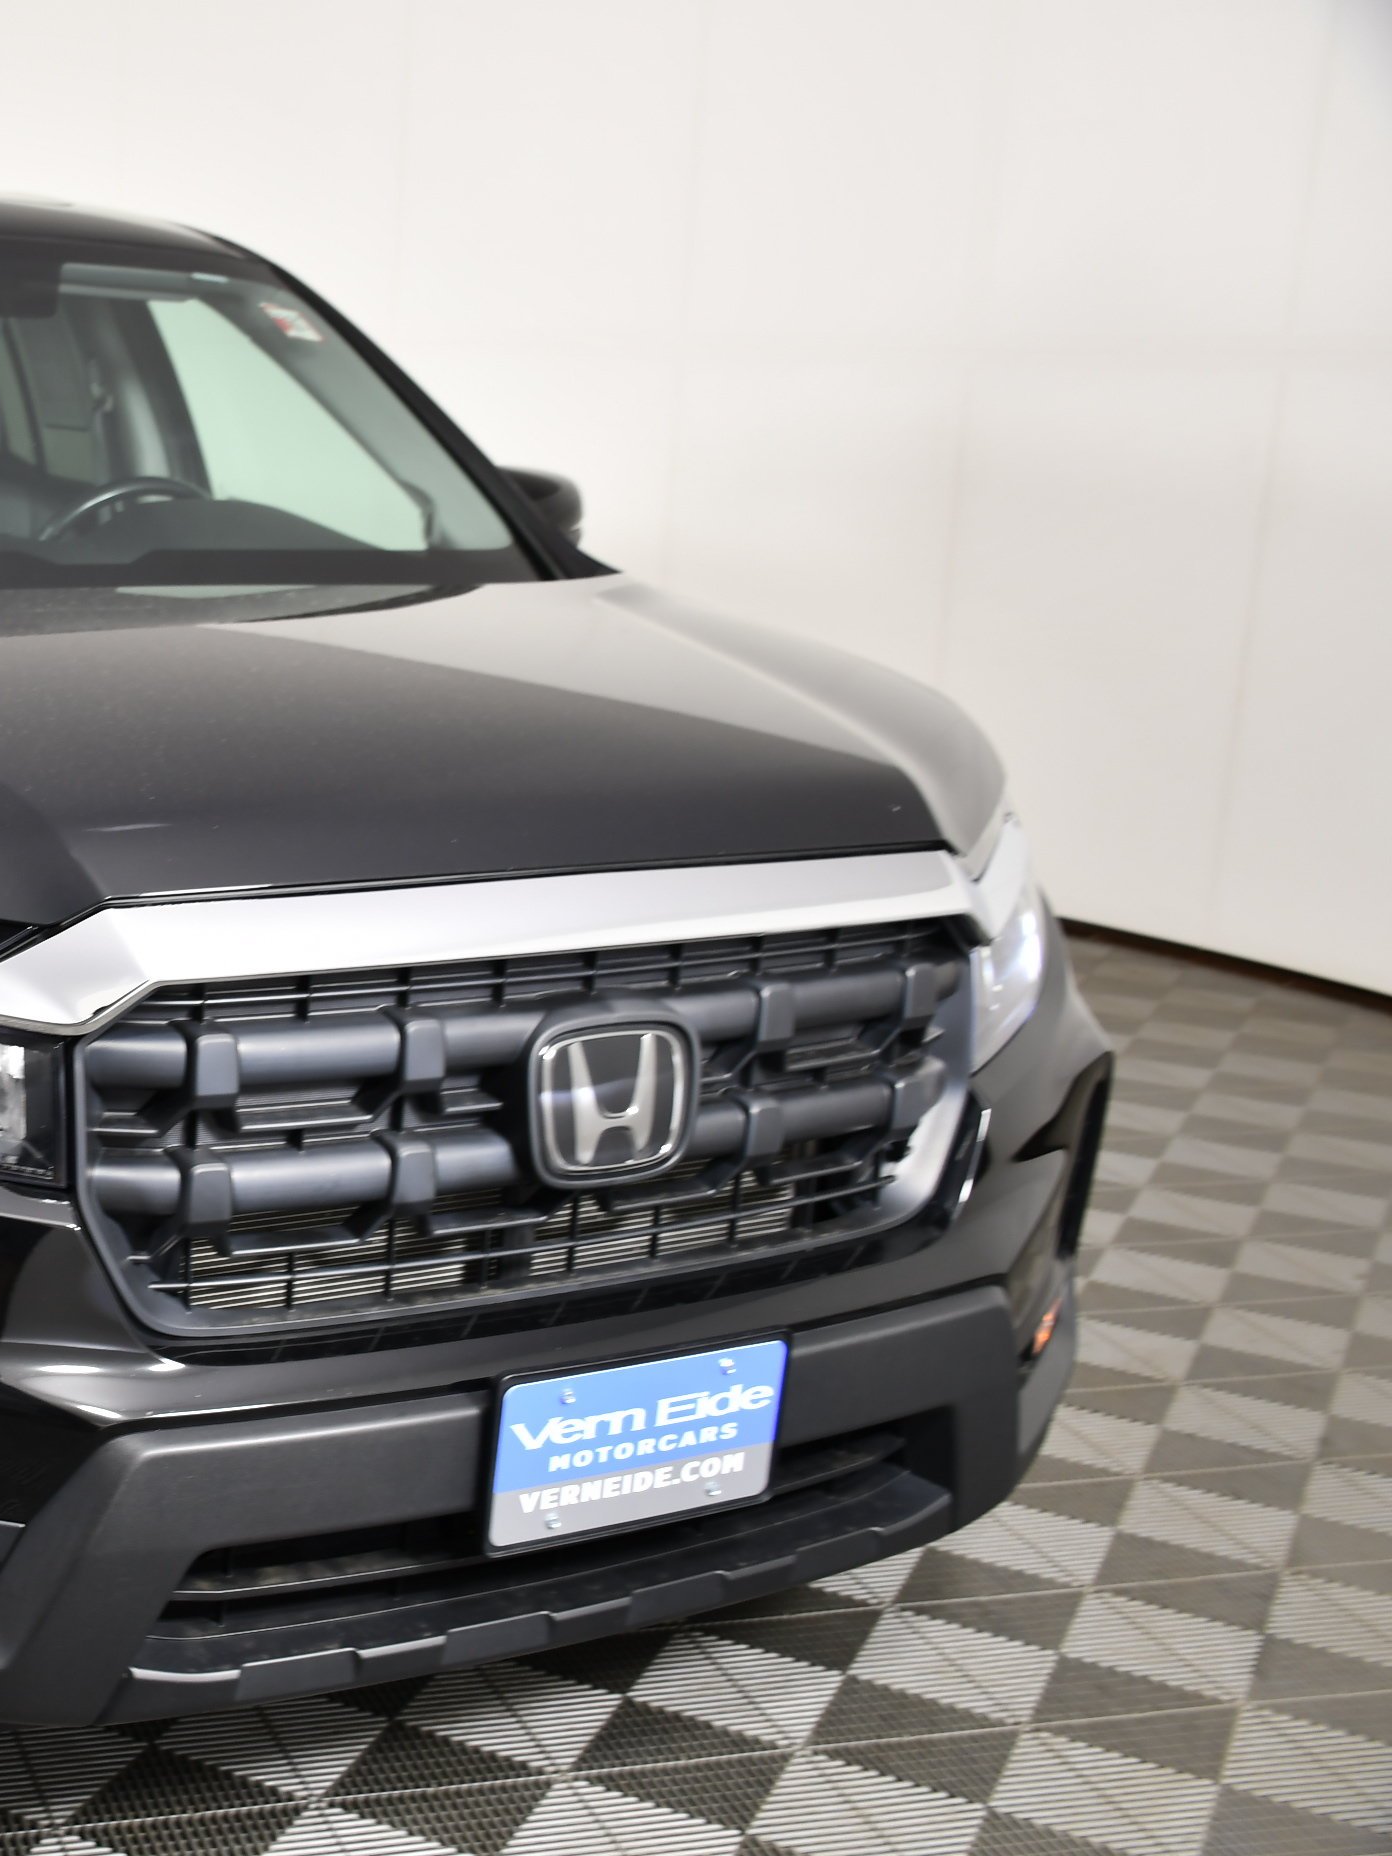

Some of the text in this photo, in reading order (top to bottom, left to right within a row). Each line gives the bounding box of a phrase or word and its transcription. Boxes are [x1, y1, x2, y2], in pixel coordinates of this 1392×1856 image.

[510, 1383, 775, 1450] Vern Eide
[547, 1422, 739, 1472] MOTORCARS
[519, 1452, 745, 1514] VERNEIDE.COM
